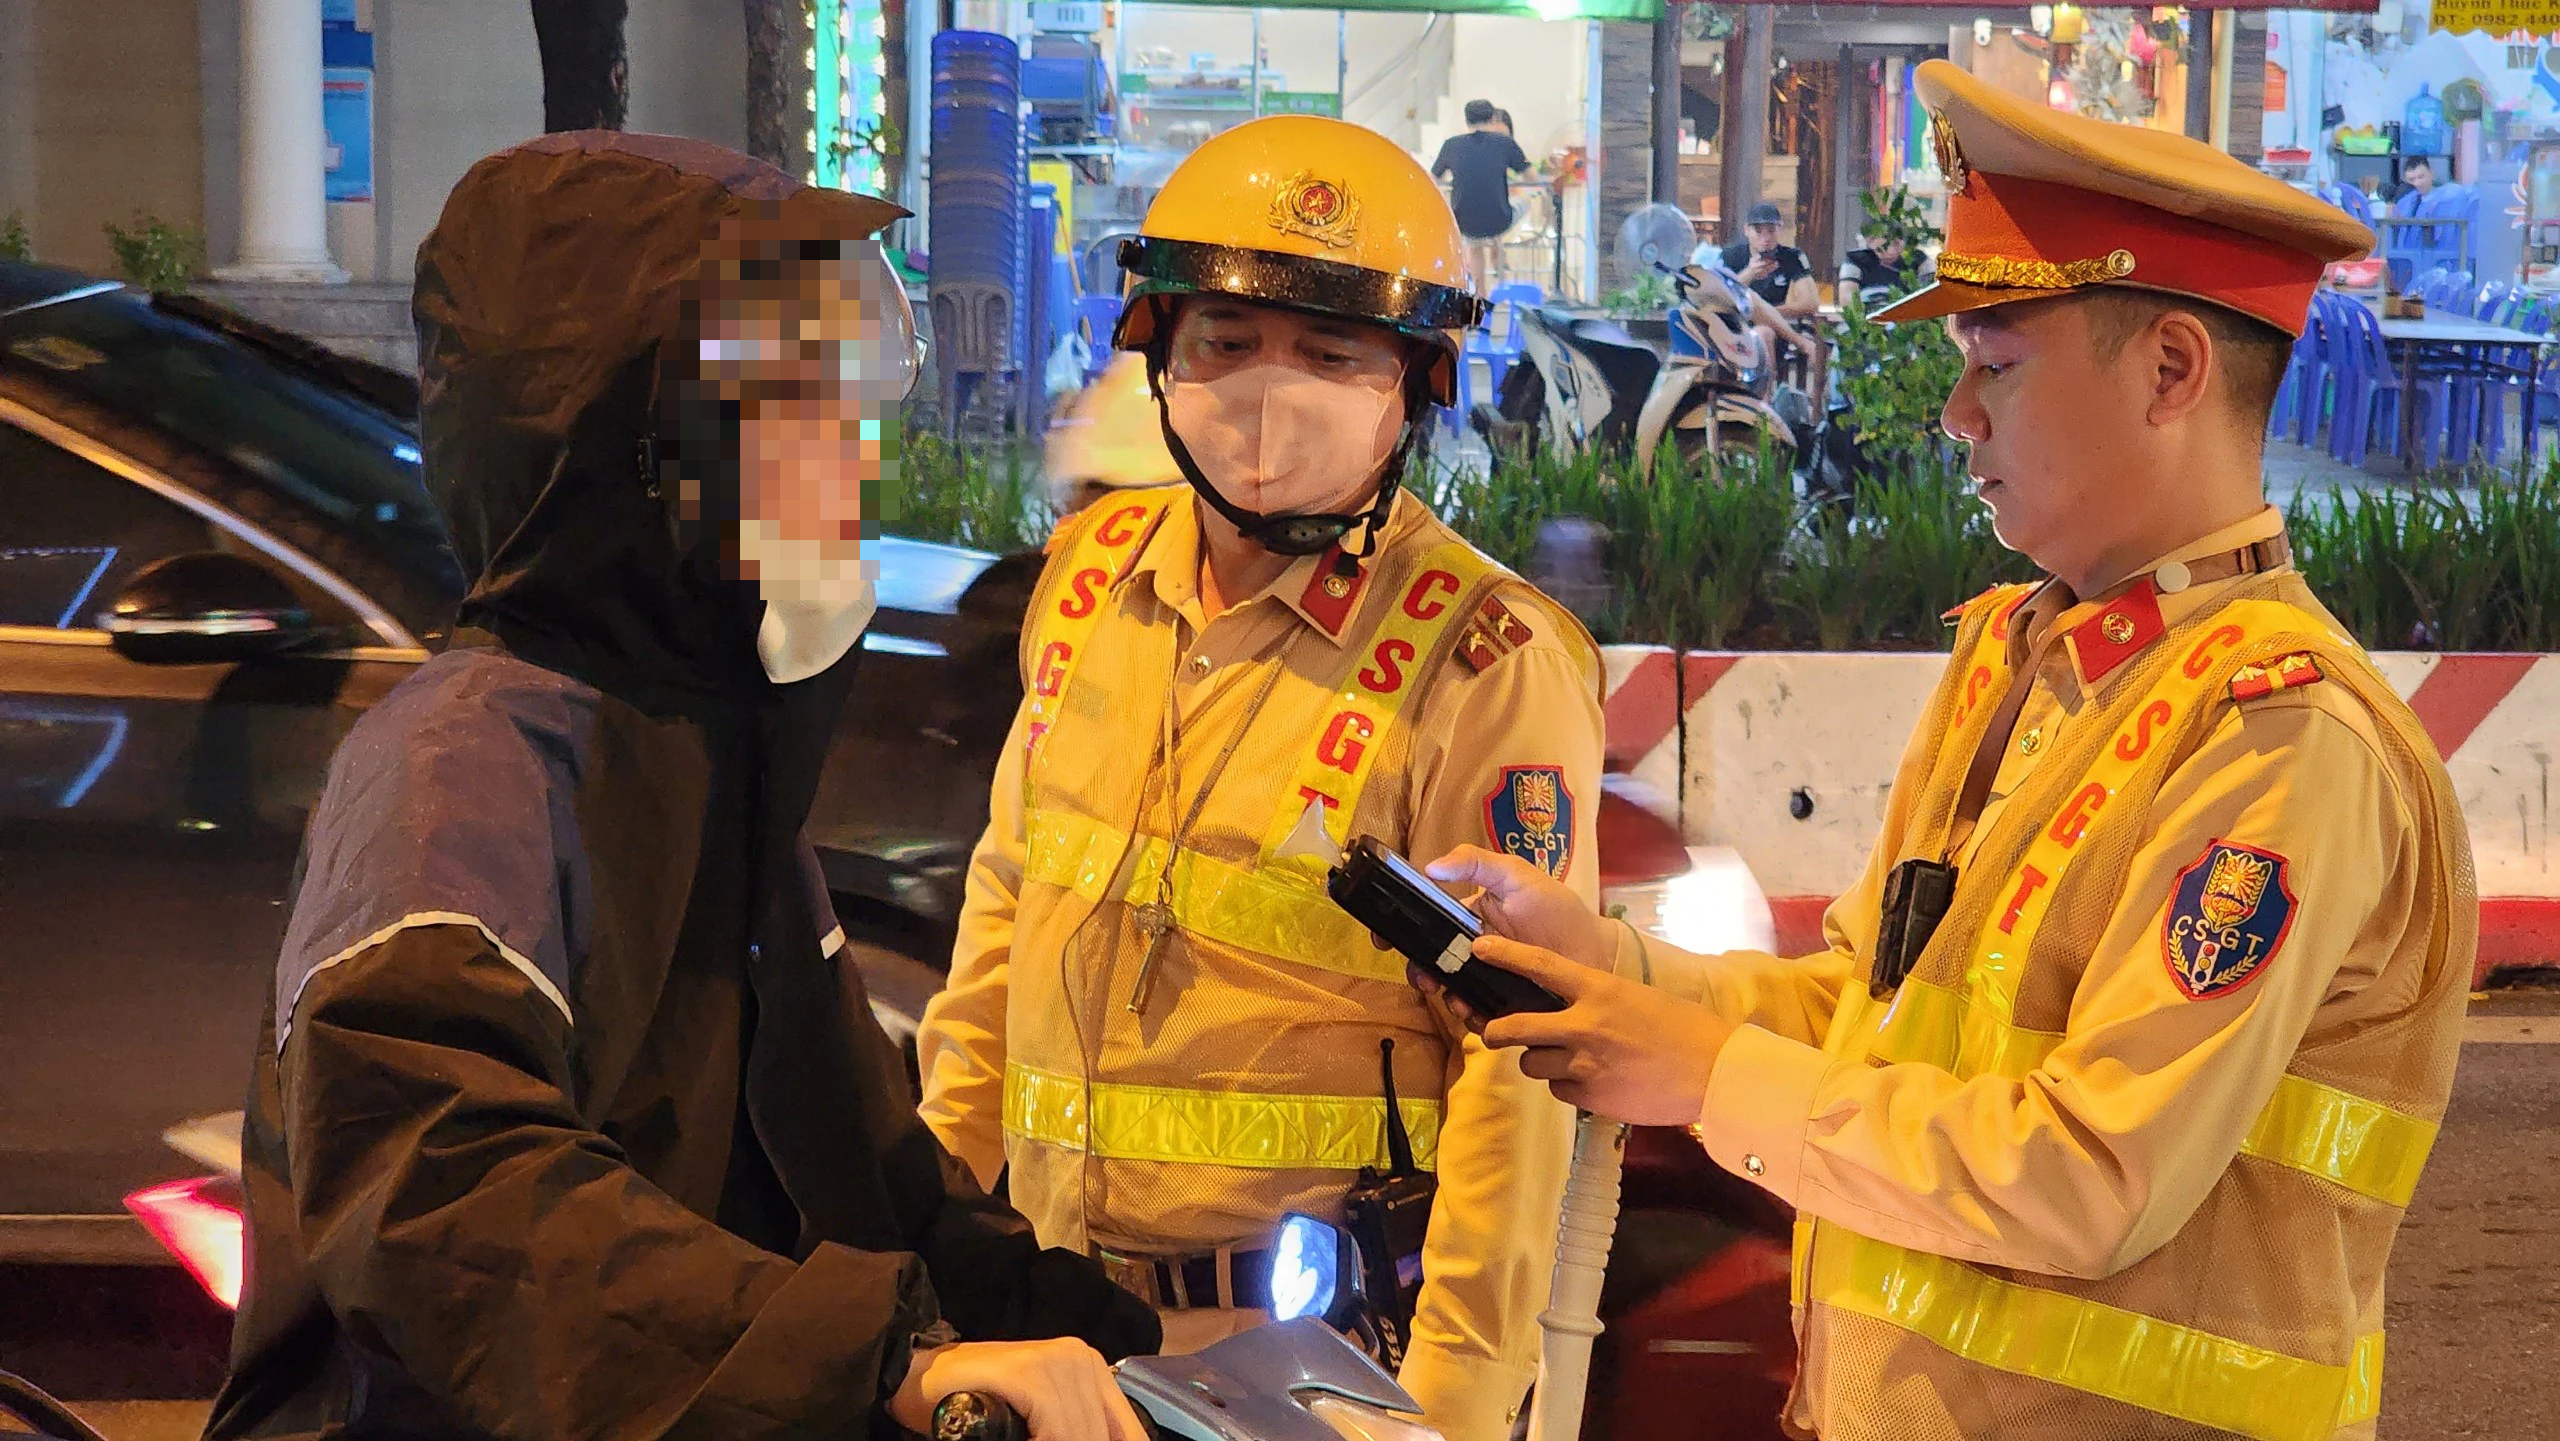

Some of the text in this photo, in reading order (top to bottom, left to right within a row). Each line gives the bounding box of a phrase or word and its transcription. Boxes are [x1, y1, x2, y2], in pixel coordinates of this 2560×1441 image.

[2472, 14, 2518, 25] 0982
[1025, 505, 1148, 778] CSGT
[1996, 623, 2244, 934] CSGT
